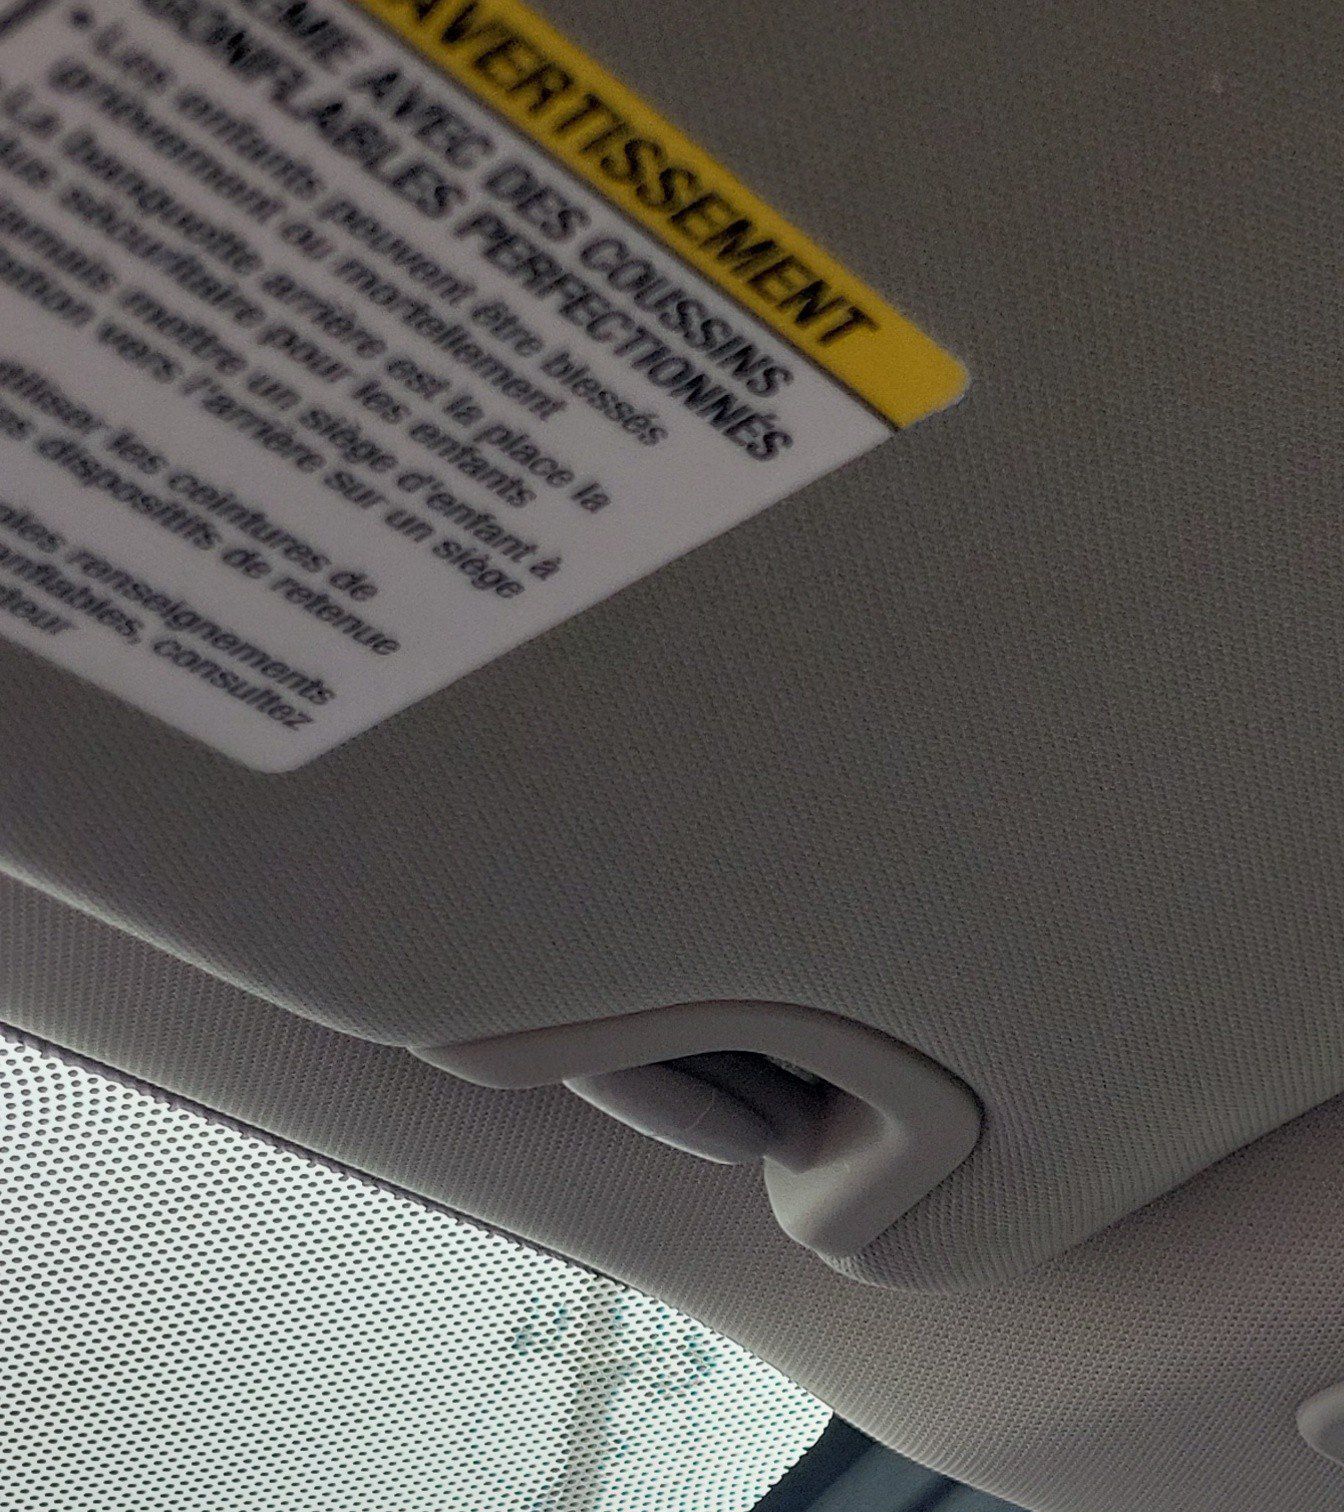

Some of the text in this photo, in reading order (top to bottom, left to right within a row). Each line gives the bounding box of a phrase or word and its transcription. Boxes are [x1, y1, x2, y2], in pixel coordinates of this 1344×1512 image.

[174, 86, 324, 200] enfants
[316, 198, 476, 305] peuvent
[470, 298, 545, 358] être
[540, 349, 669, 447] blessés
[277, 219, 335, 262] ou
[333, 255, 569, 423] mortellement
[348, 66, 495, 170] AVEC
[484, 161, 592, 242] DES
[580, 236, 794, 399] COUSSINS
[453, 210, 794, 463] PERFECTIONNÉS
[180, 370, 328, 474] l'arrière
[321, 468, 387, 511] sur
[383, 509, 435, 543] un
[431, 537, 526, 599] siège
[246, 370, 303, 412] un
[298, 405, 399, 473] siège
[395, 470, 538, 563] d'enfant
[528, 555, 563, 582] à
[256, 324, 353, 384] pour
[352, 378, 410, 425] les
[408, 421, 537, 508] enfants
[260, 272, 388, 359] arrière
[384, 354, 451, 400] est
[443, 393, 485, 427] la
[472, 423, 575, 489] place
[570, 480, 612, 514] la
[34, 436, 223, 550] dispositifs
[219, 546, 272, 579] de
[268, 576, 403, 656] retenue
[106, 427, 170, 476] les
[165, 464, 332, 574] ceintures
[327, 568, 379, 602] de
[65, 547, 337, 706] renseignements
[151, 636, 315, 730] consultez
